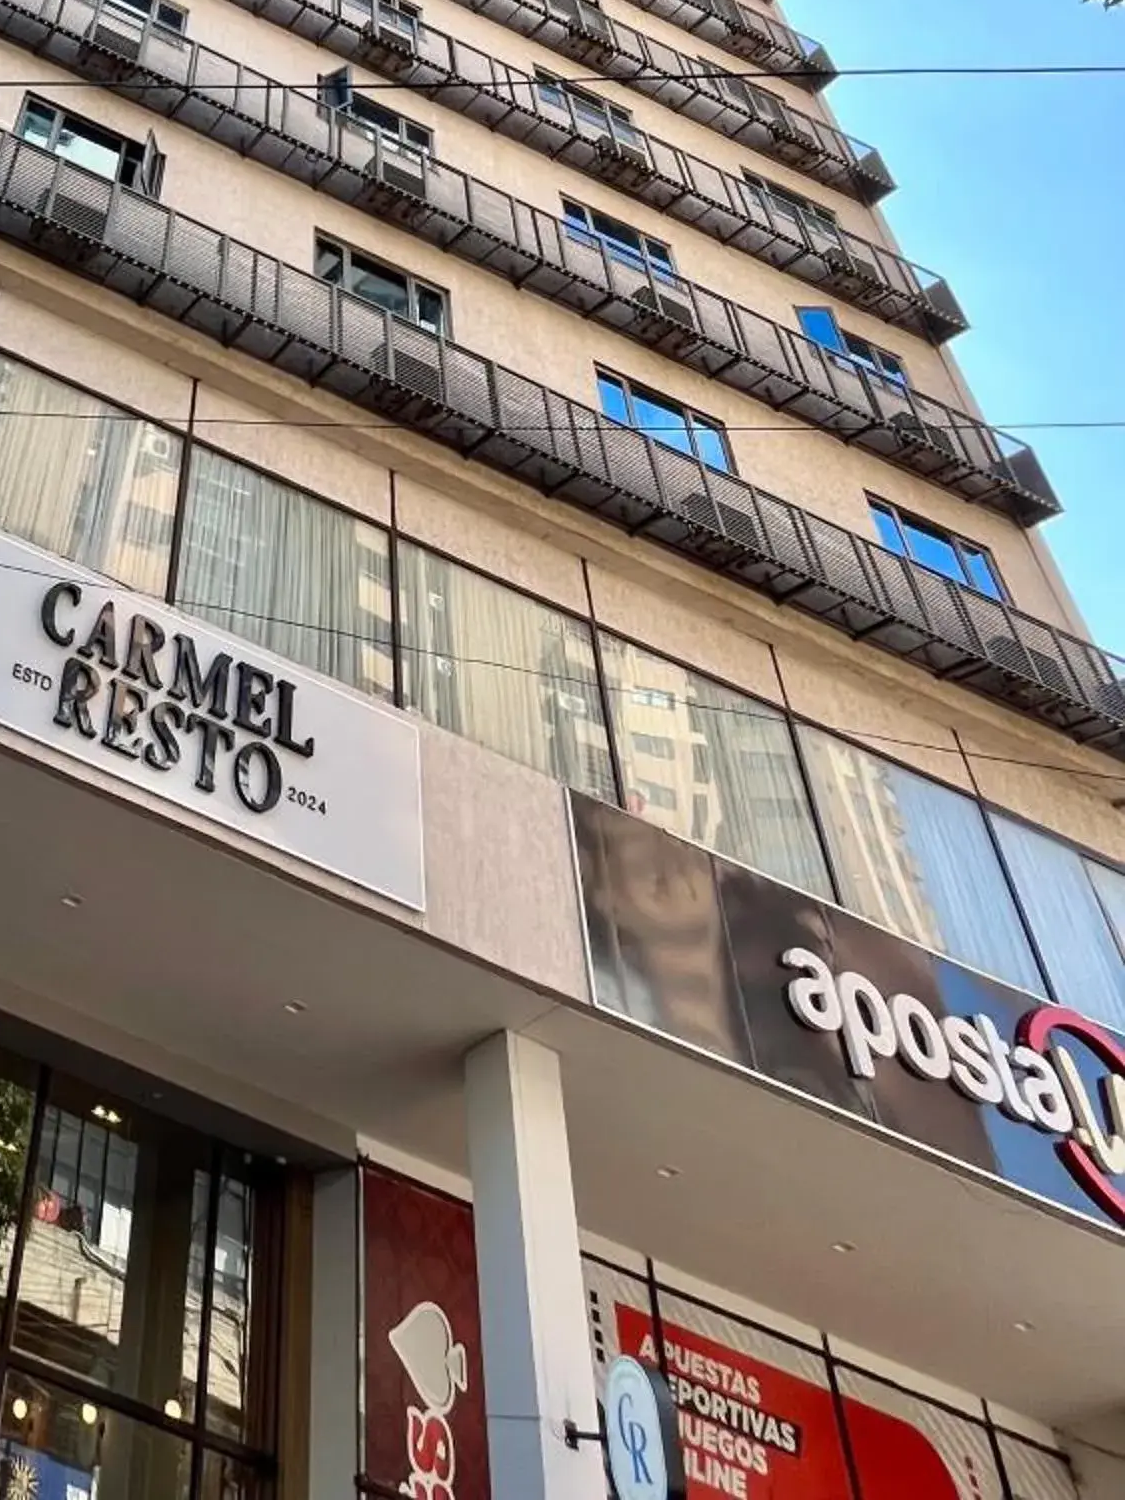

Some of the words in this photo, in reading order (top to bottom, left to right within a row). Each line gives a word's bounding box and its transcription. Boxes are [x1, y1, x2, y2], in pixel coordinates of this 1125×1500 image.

[40, 581, 315, 759] CARMEL
[52, 656, 282, 814] RESTO
[286, 786, 327, 815] 2024
[638, 1333, 762, 1405] APUESTAS
[668, 1373, 797, 1453] EPORTIVAS
[682, 1446, 748, 1500] LINE
